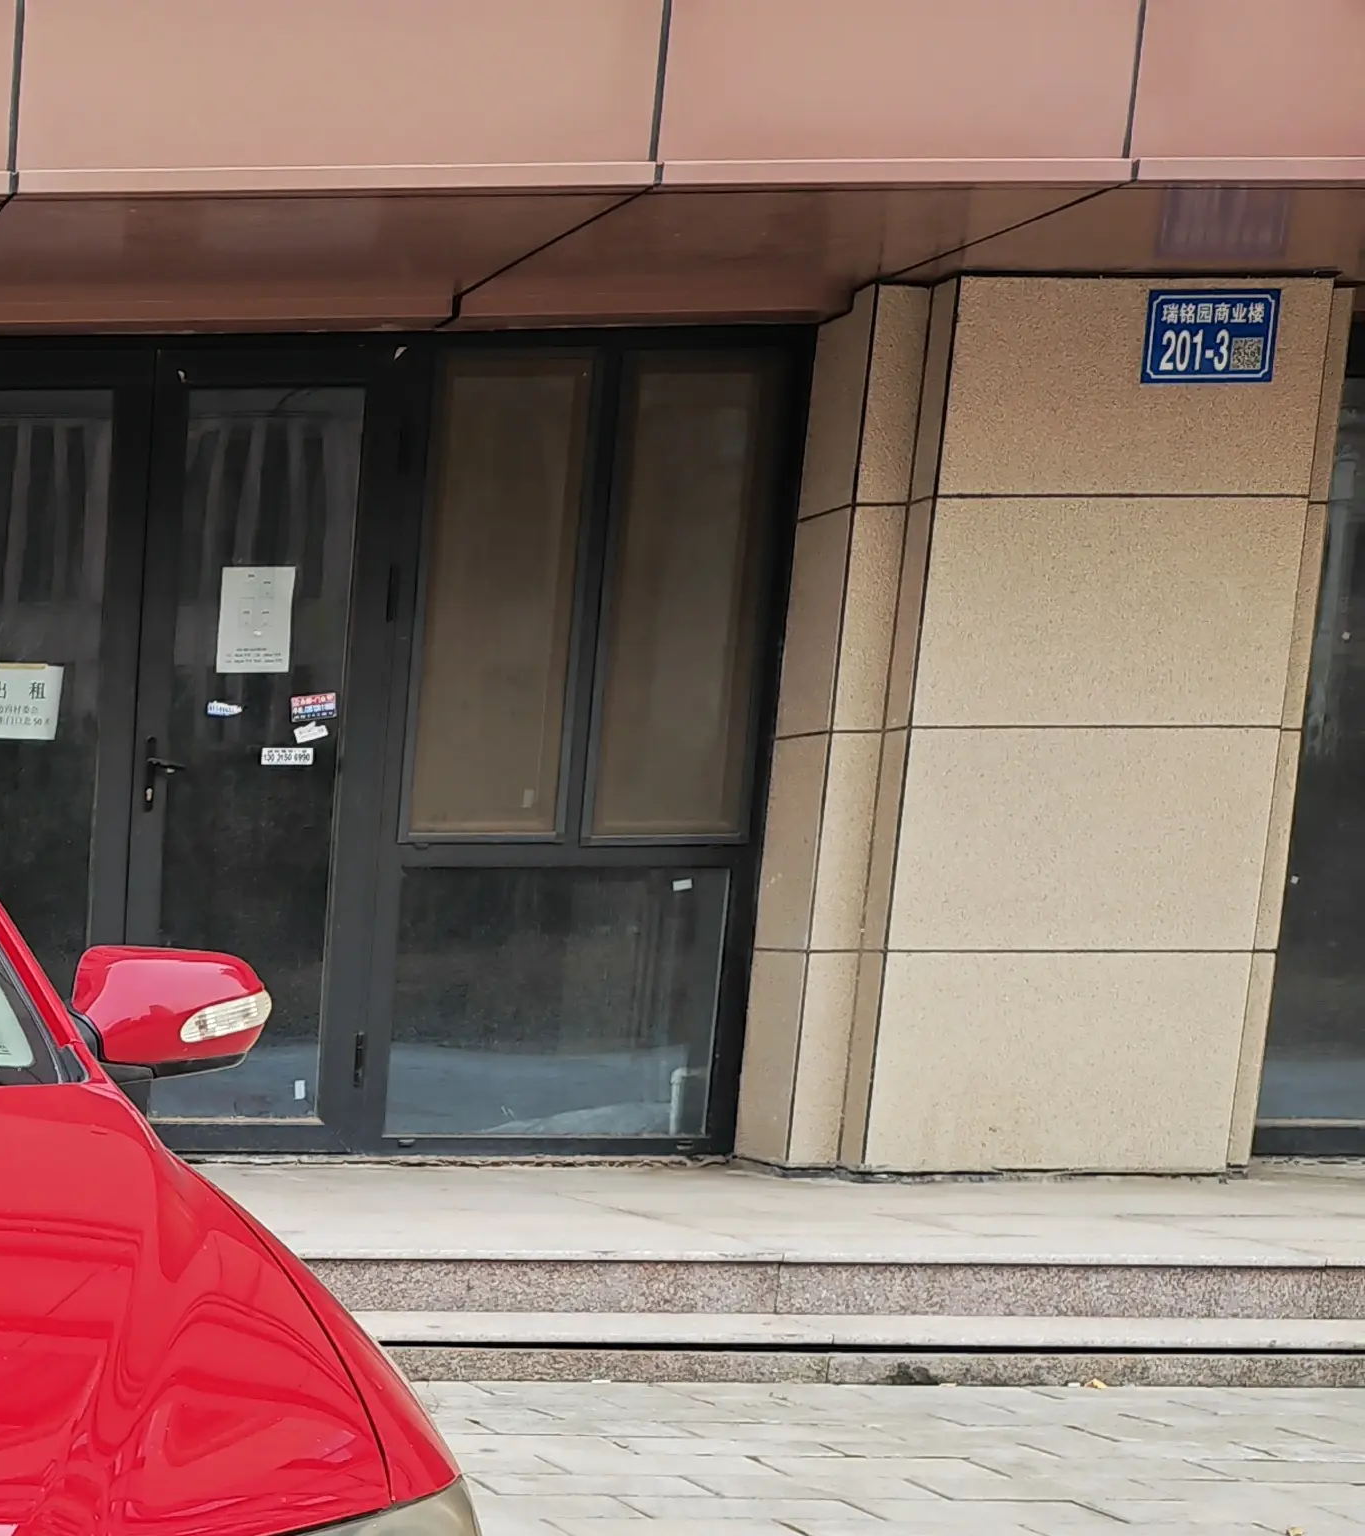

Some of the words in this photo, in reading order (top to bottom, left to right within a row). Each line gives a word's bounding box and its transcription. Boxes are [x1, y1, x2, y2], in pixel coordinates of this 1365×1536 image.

[1161, 302, 1265, 325] 瑞铭园商业楼
[1159, 328, 1230, 372] 201-3
